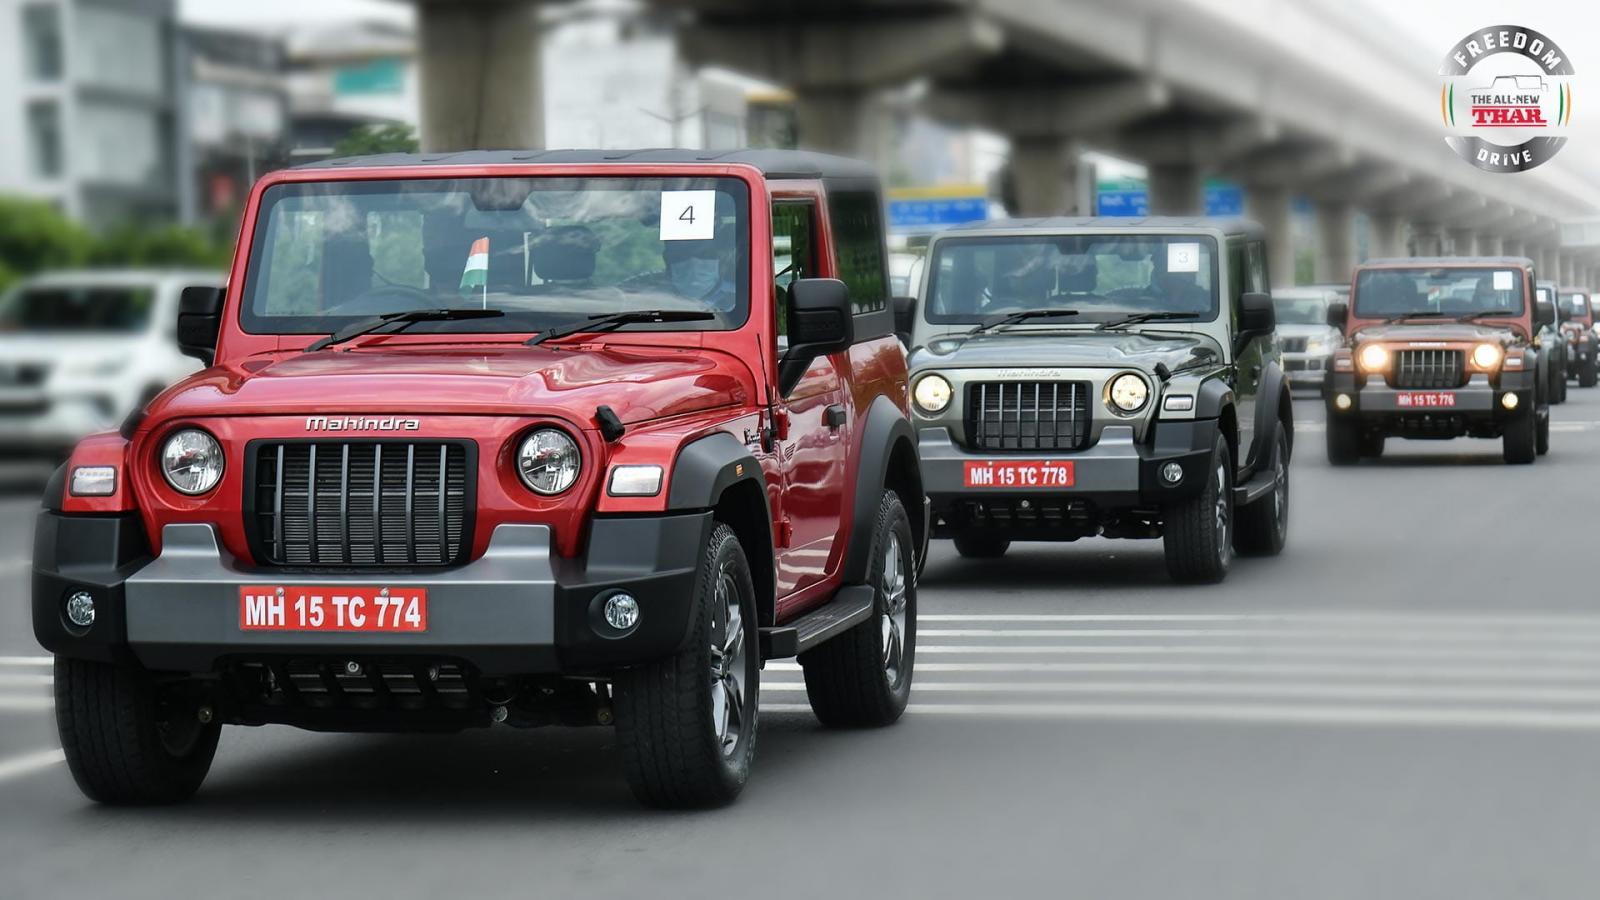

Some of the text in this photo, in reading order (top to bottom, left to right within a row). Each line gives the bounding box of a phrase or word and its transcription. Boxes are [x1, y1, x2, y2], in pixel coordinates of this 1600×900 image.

[679, 205, 696, 224] 4
[1414, 394, 1424, 405] 15
[1425, 394, 1437, 405] TC
[305, 416, 420, 431] Mahindra
[970, 467, 1067, 484] MH 15 TC 778
[245, 595, 421, 627] MH 15 TC 774
